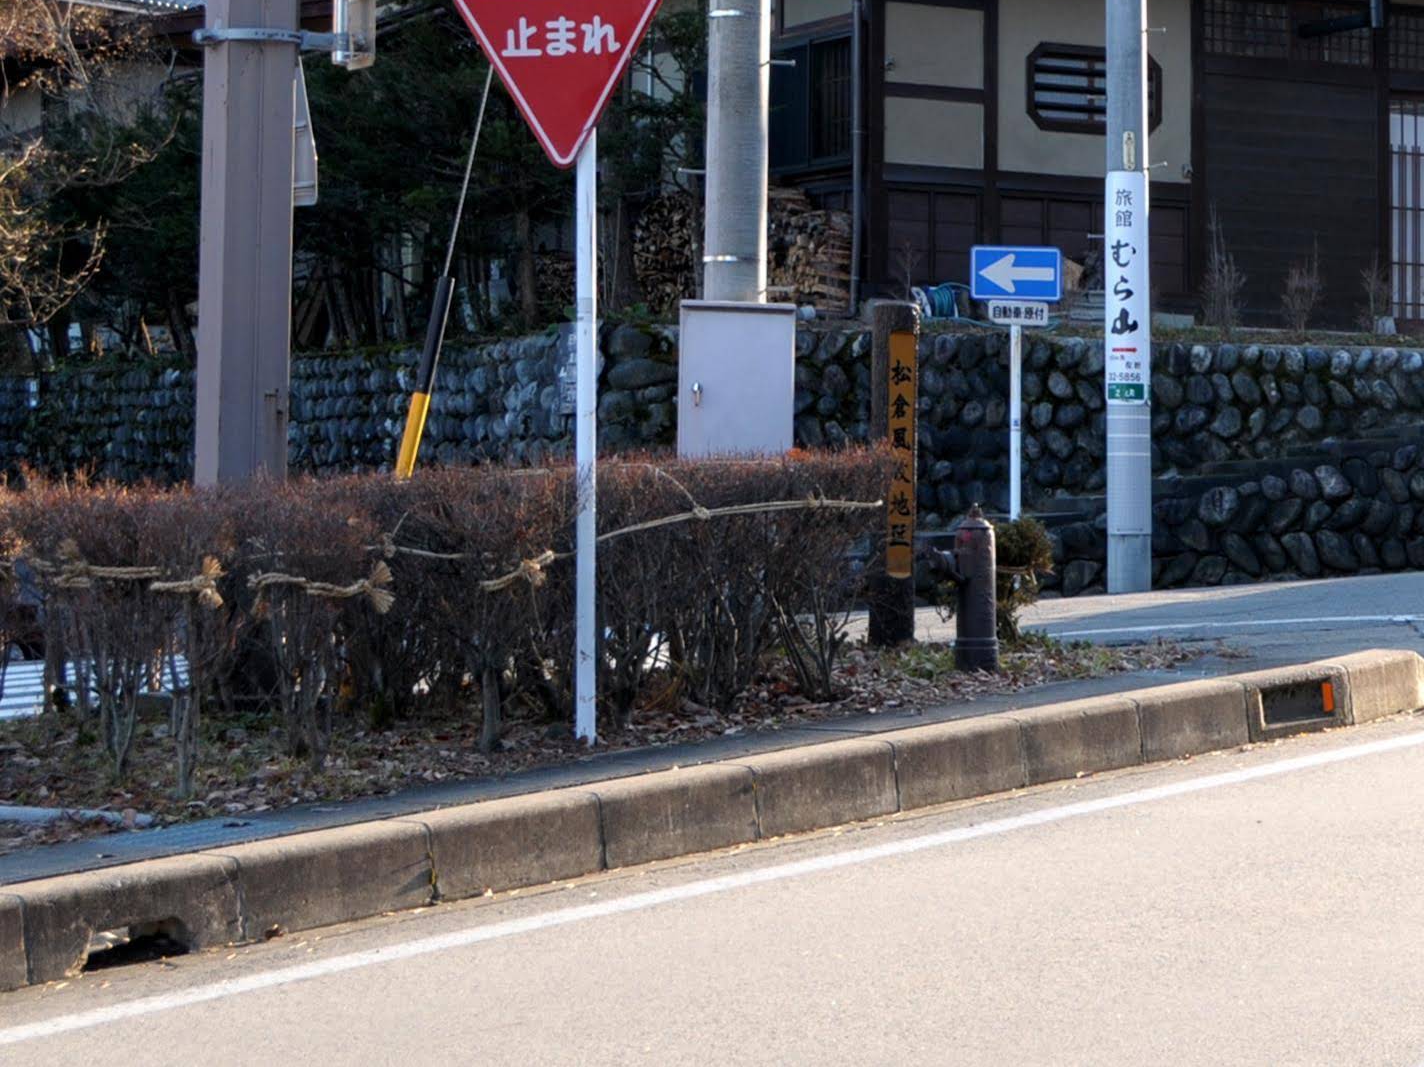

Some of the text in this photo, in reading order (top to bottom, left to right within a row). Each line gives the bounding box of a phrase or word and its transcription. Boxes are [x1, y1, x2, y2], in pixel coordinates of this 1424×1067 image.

[501, 15, 621, 58] 止まれ
[1115, 188, 1133, 227] 旅館
[1111, 239, 1139, 335] むら山
